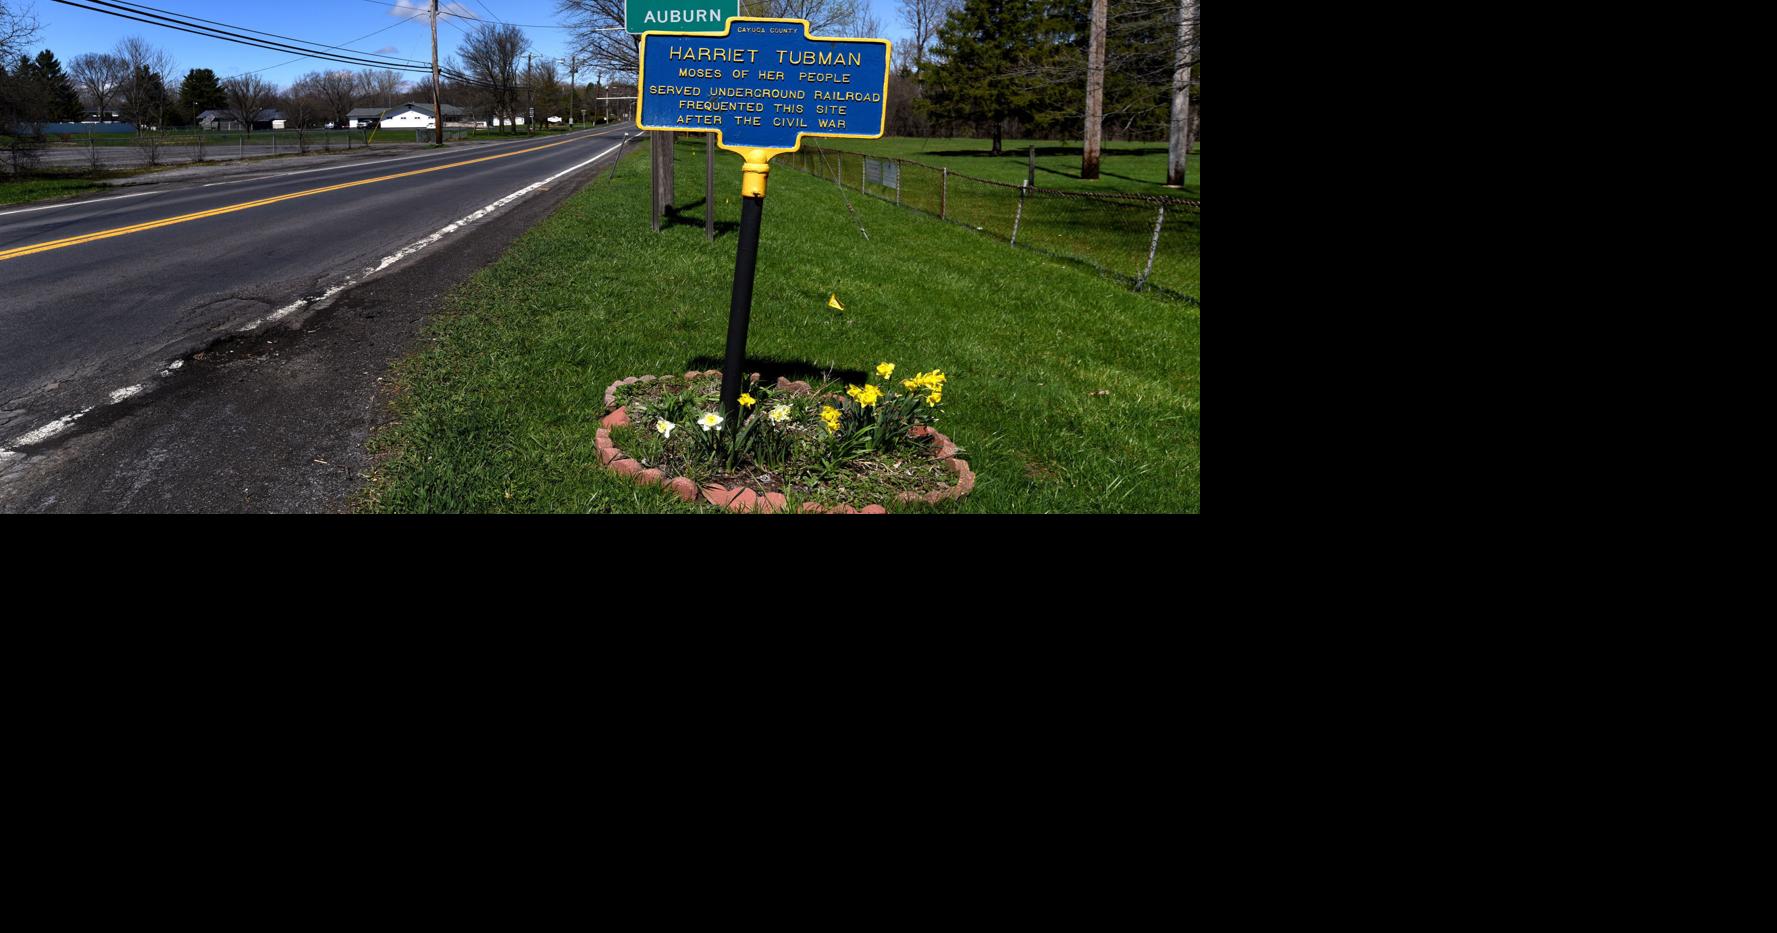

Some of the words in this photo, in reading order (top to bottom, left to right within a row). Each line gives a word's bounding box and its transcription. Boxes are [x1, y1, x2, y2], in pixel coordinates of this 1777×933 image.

[644, 8, 722, 24] AUBURN
[669, 46, 759, 63] HARRIET
[776, 50, 862, 66] TUBMAN
[679, 68, 722, 79] MOSES
[732, 69, 750, 79] OF
[758, 70, 785, 81] HER
[799, 72, 851, 84] PEOPLE
[649, 85, 701, 96] SERVED
[709, 87, 806, 100] UNDERGROUND
[814, 90, 881, 103] RAILROAD
[679, 100, 764, 112] FREQUENTED
[773, 104, 804, 114] THIS
[816, 105, 847, 115] SITE
[676, 115, 722, 125] AFTER
[734, 116, 761, 126] THE
[773, 118, 808, 128] CIVIL
[818, 119, 847, 129] WAR
